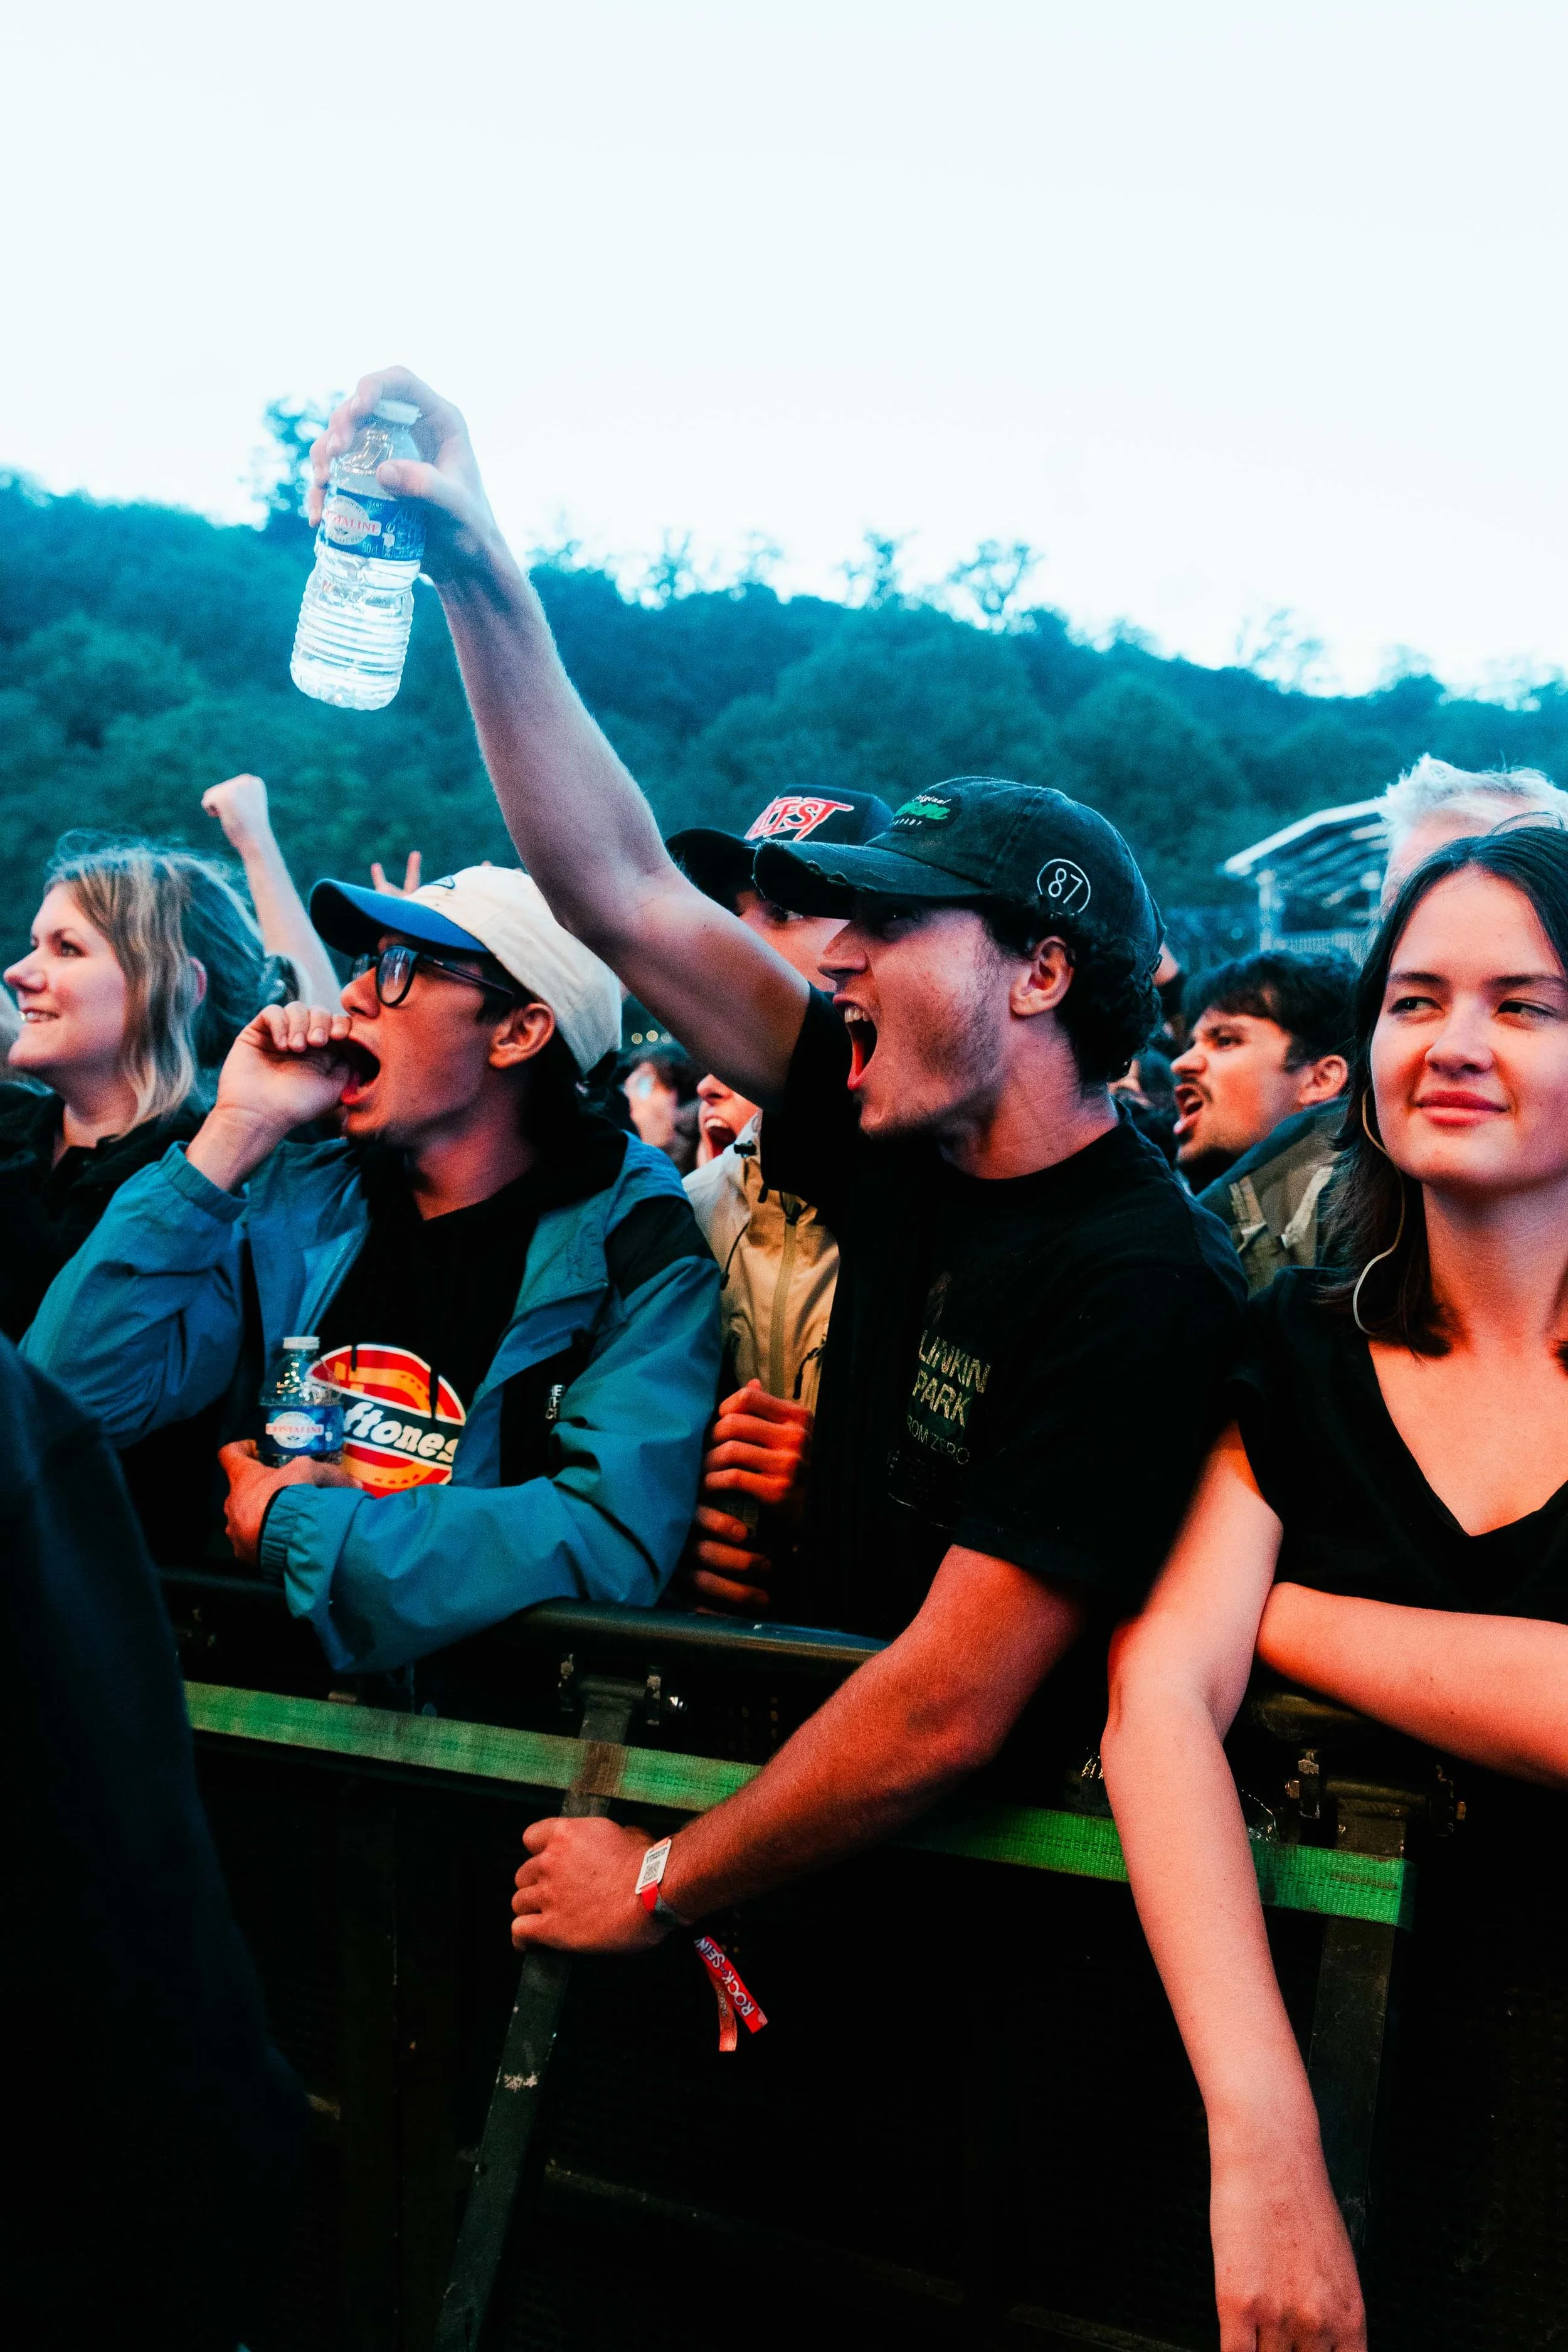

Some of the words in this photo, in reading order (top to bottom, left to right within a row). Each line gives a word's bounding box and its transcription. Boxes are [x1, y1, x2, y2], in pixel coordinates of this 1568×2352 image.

[1048, 867, 1083, 904] 87
[918, 1329, 991, 1394] LINKIN
[911, 1369, 971, 1428] PARK
[343, 1401, 459, 1463] ftones
[906, 1414, 930, 1446] ROM
[930, 1432, 970, 1466] ZERO
[694, 1937, 726, 1968] SEIN
[723, 1970, 755, 2016] ROCK
